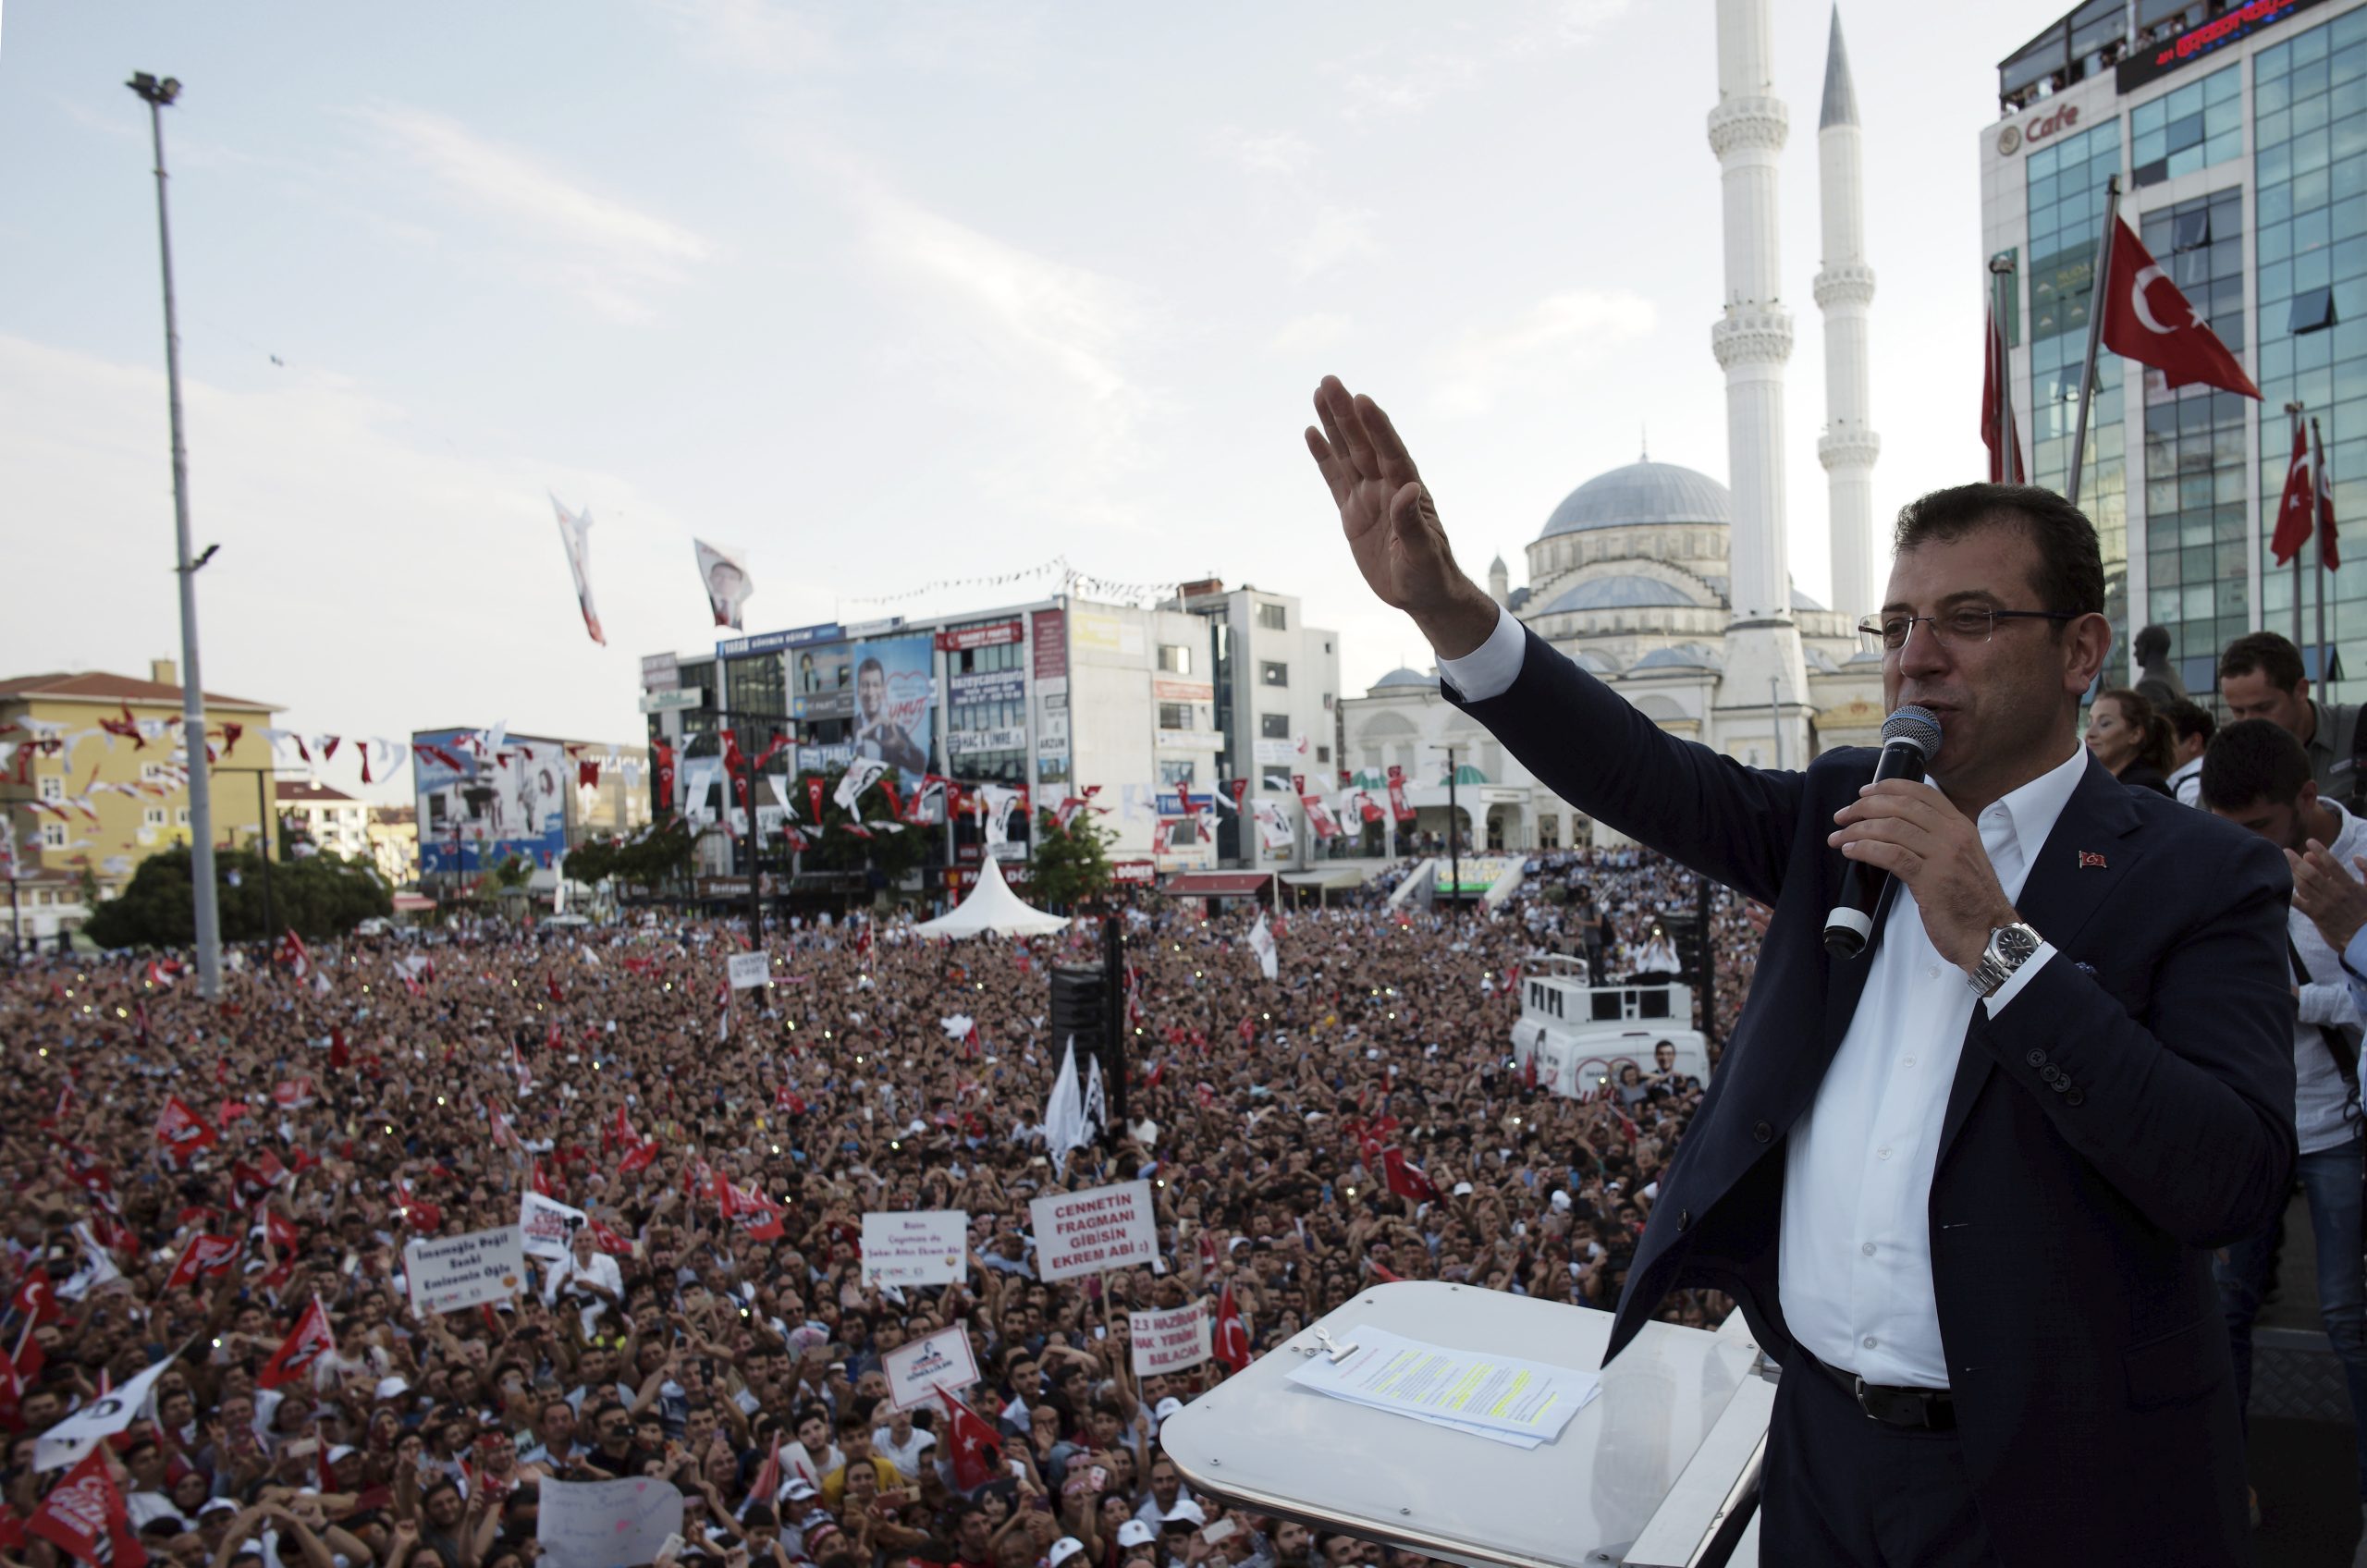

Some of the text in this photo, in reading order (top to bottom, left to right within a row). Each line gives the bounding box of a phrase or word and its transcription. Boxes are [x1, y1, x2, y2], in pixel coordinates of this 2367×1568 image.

[2026, 103, 2079, 143] Cafe
[889, 697, 927, 717] UMUT
[1055, 1193, 1133, 1219] CENNETİN
[1056, 1209, 1135, 1235] FRAGMANI
[417, 1232, 509, 1260] İmamoğlu Değil
[1070, 1227, 1126, 1249] GİBİSİN
[1052, 1249, 1105, 1268] EKREM
[1110, 1241, 1135, 1257] ABİ
[484, 1264, 510, 1278] Oğlu
[1134, 1318, 1149, 1331] 23
[1134, 1337, 1155, 1350] HAK
[1149, 1342, 1201, 1366] BULACAK
